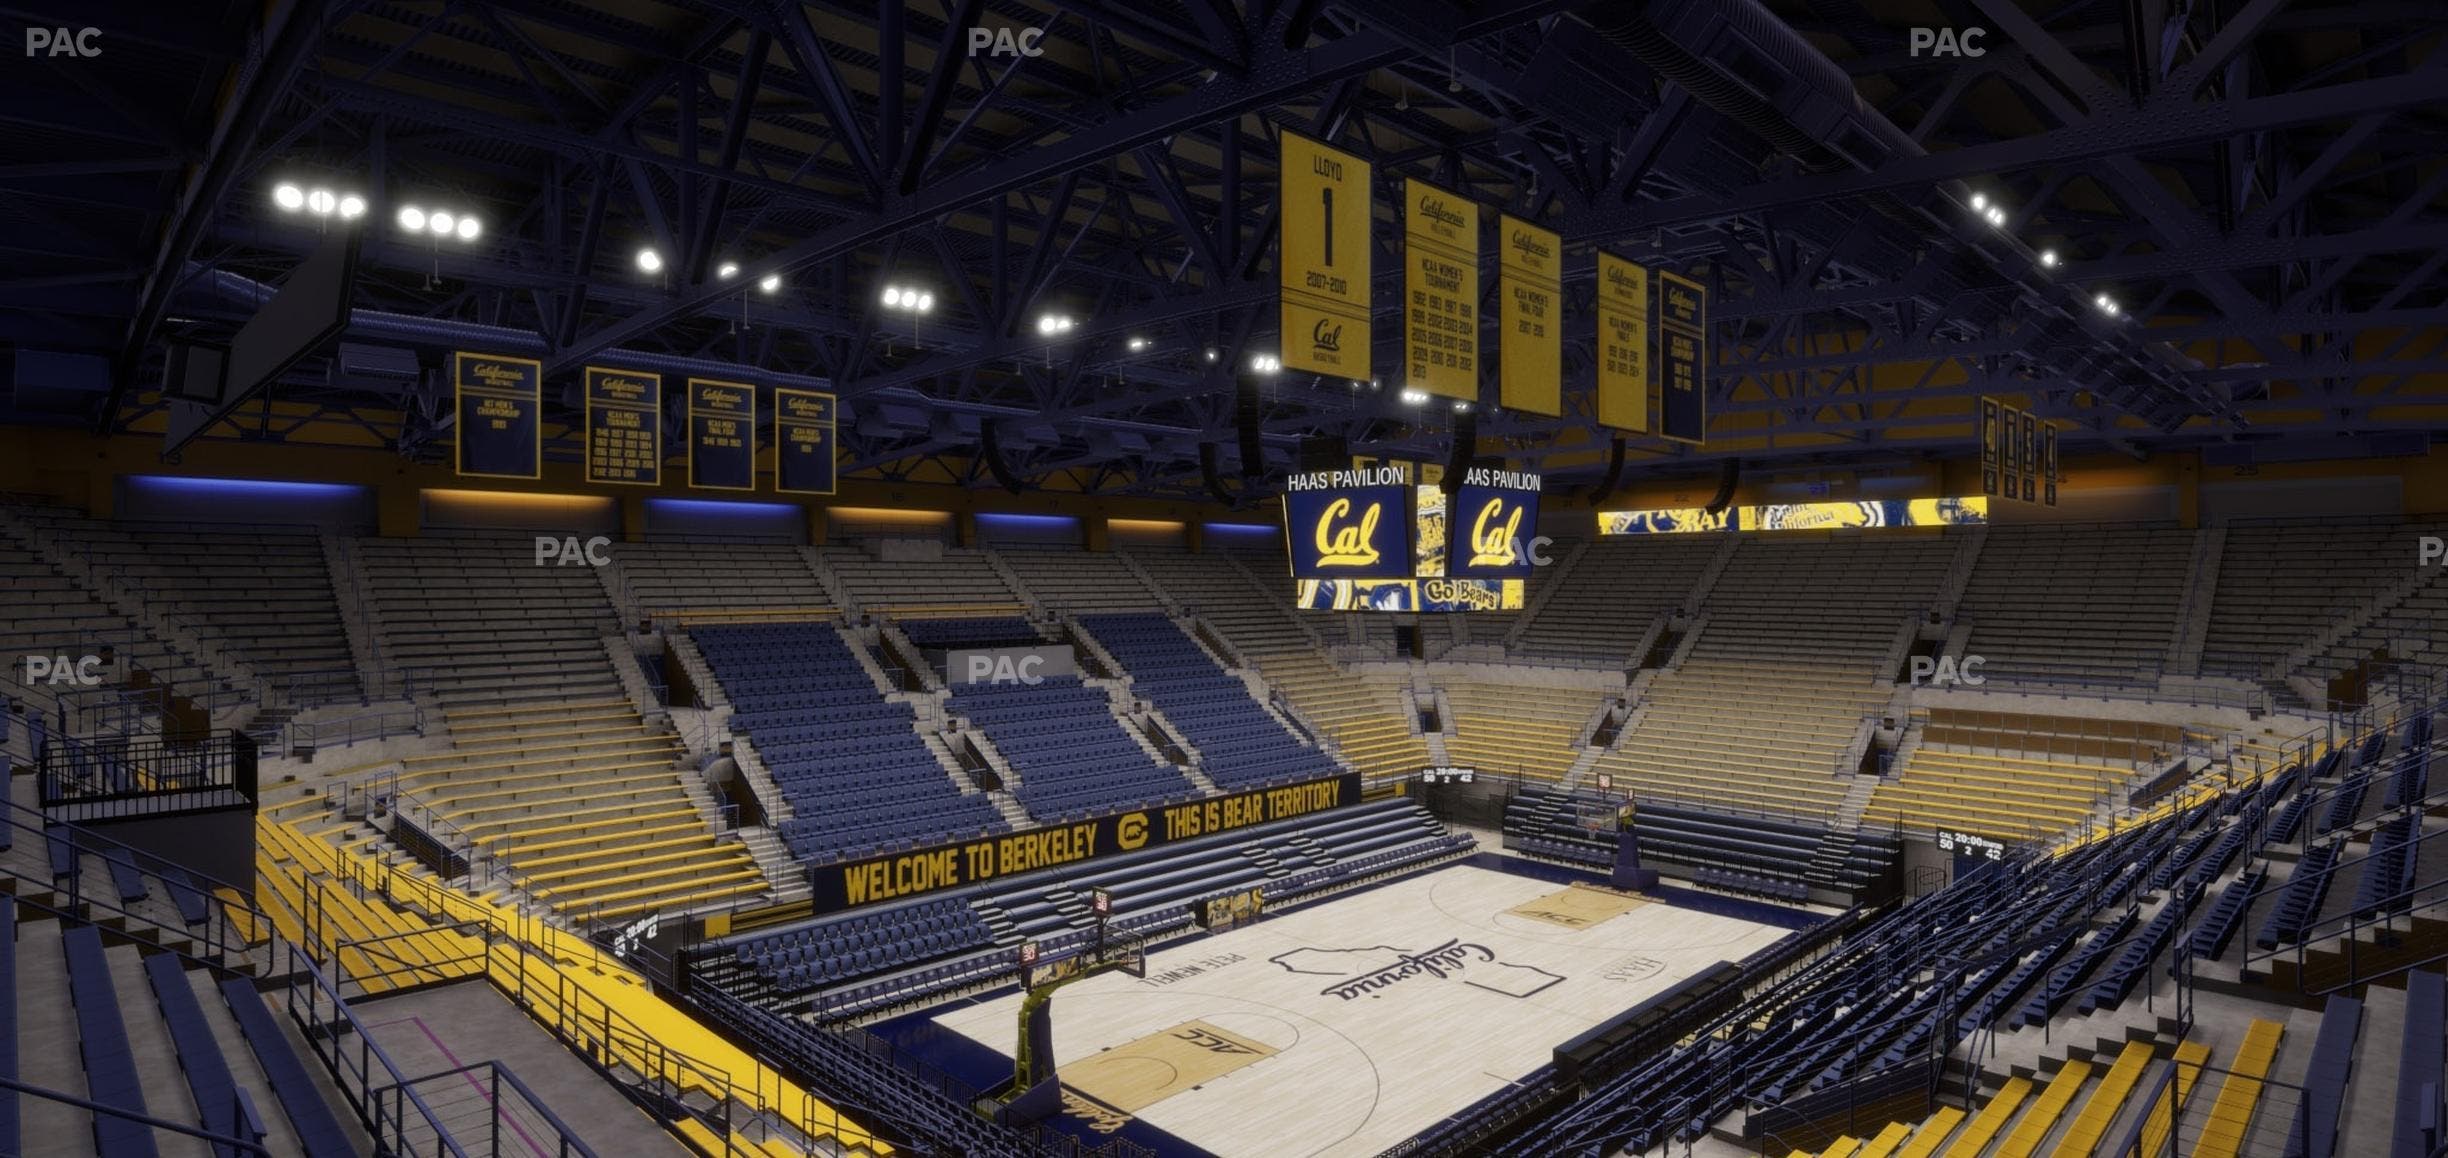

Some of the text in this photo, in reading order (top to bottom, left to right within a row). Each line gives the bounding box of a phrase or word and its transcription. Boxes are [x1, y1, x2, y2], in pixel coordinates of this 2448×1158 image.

[1314, 155, 1342, 181] LLOYD
[1420, 196, 1465, 228] California
[1323, 188, 1332, 267] 1
[1513, 230, 1550, 258] California
[1307, 271, 1346, 295] 2007-2010
[1313, 319, 1341, 352] Cal
[472, 364, 524, 381] California
[601, 378, 645, 393] California
[1288, 466, 1405, 491] HAAS PAVILION
[1464, 467, 1541, 491] AAS PAVILION
[1316, 498, 1381, 568] Cal
[1468, 498, 1523, 568] Cal
[1427, 581, 1495, 608] Go Bears
[1165, 780, 1341, 841] THIS IS BEAR TERRITORY
[1939, 831, 1954, 840] CAL
[1954, 832, 1983, 846] 20:00
[1939, 839, 1954, 850] 50
[1964, 845, 1973, 856] 2
[1985, 848, 2001, 861] 42
[844, 822, 1098, 906] WELCOME TO BERKELEY
[1137, 952, 1247, 987] PETE NEWELL
[1320, 938, 1495, 1001] California
[1169, 1028, 1265, 1055] ACC
